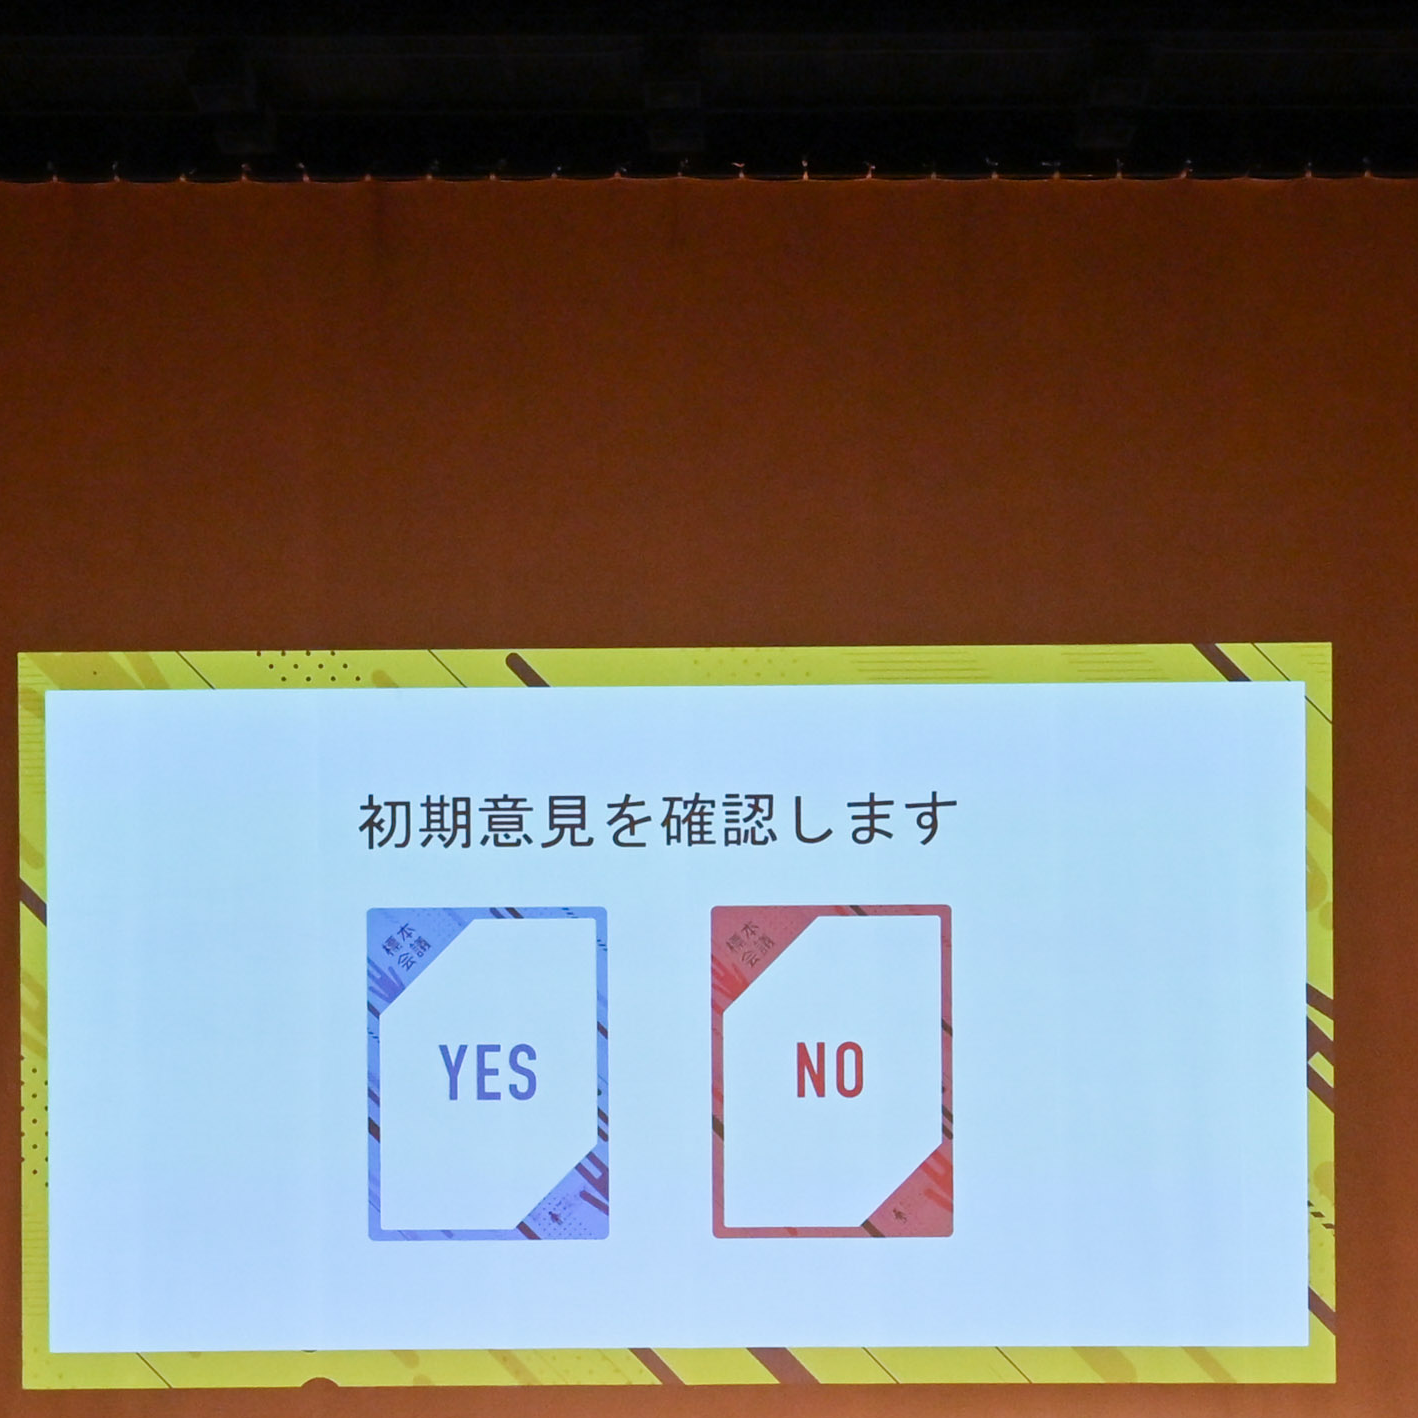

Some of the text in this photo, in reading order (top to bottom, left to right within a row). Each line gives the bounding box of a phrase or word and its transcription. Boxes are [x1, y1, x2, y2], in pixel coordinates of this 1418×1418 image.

[359, 791, 958, 850] 初期意見を確認します
[438, 1043, 538, 1102] YES
[796, 1041, 865, 1099] NO
